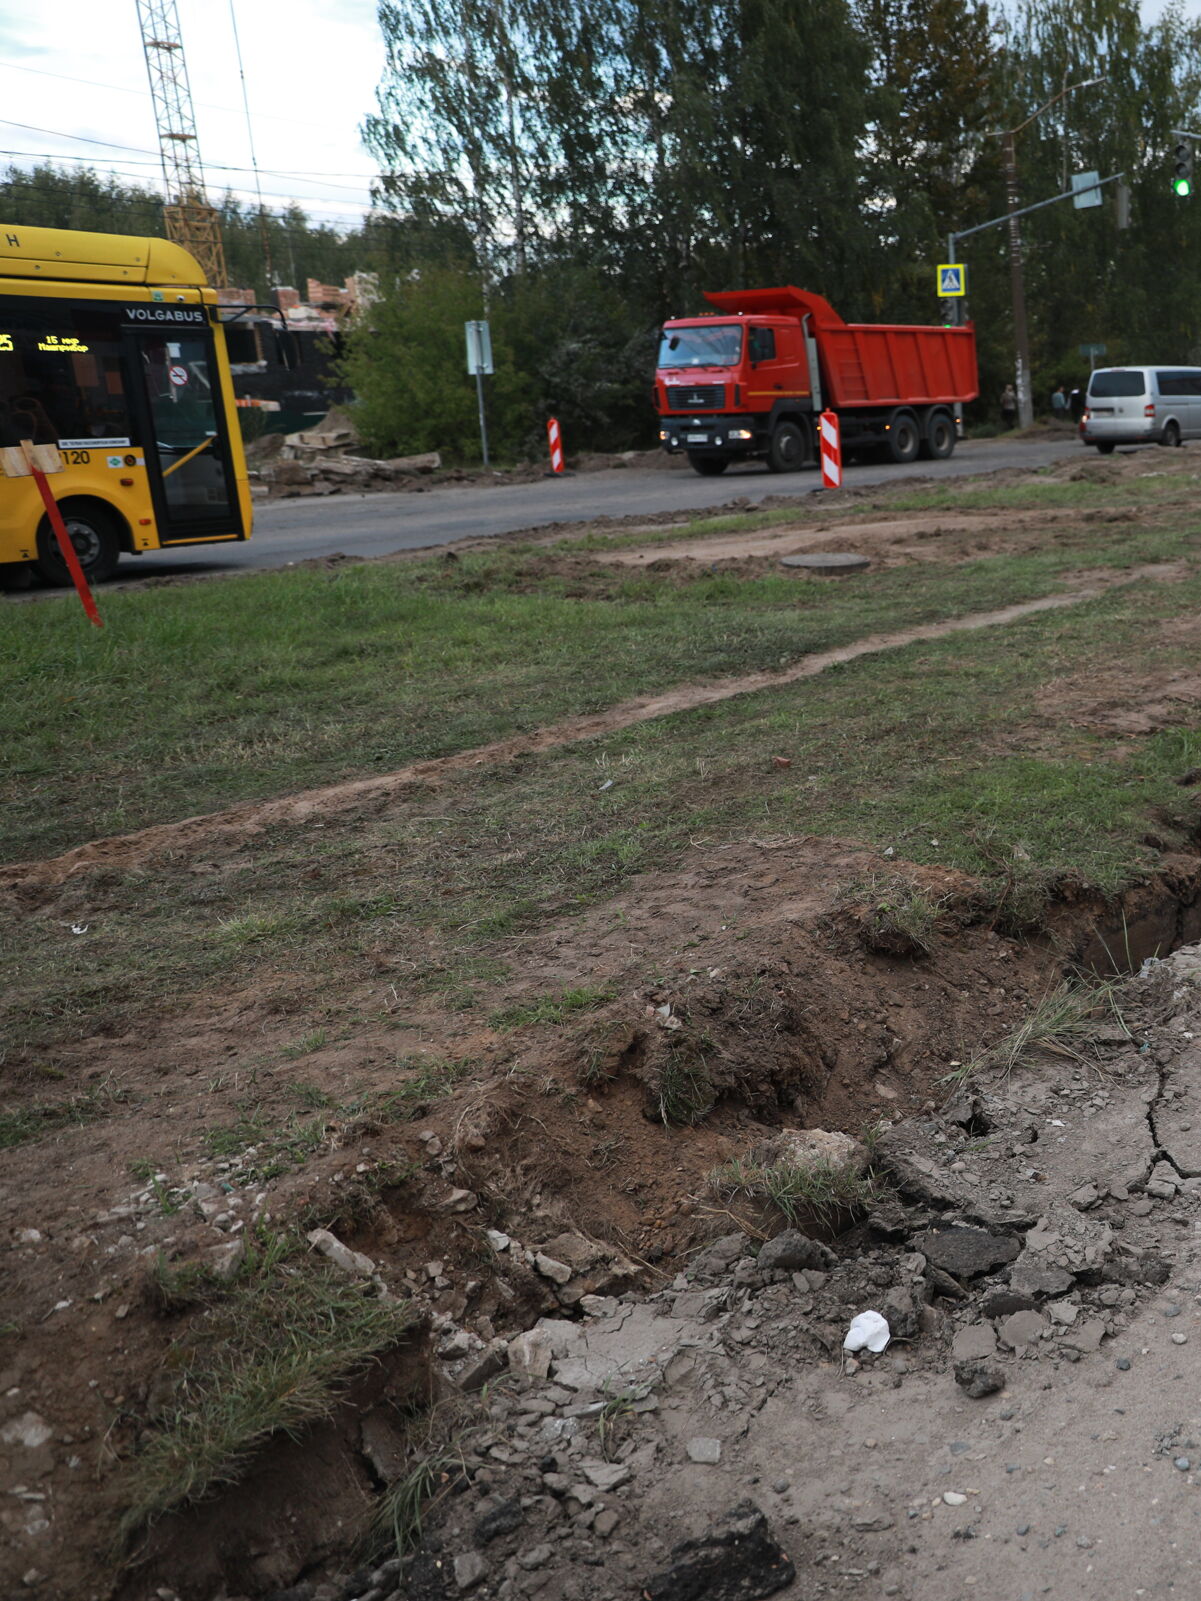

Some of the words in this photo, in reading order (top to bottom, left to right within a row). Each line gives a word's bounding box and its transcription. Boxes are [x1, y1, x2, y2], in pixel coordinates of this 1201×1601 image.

[126, 308, 203, 322] VOLGABUS
[0, 334, 13, 351] 5
[45, 335, 58, 344] 15
